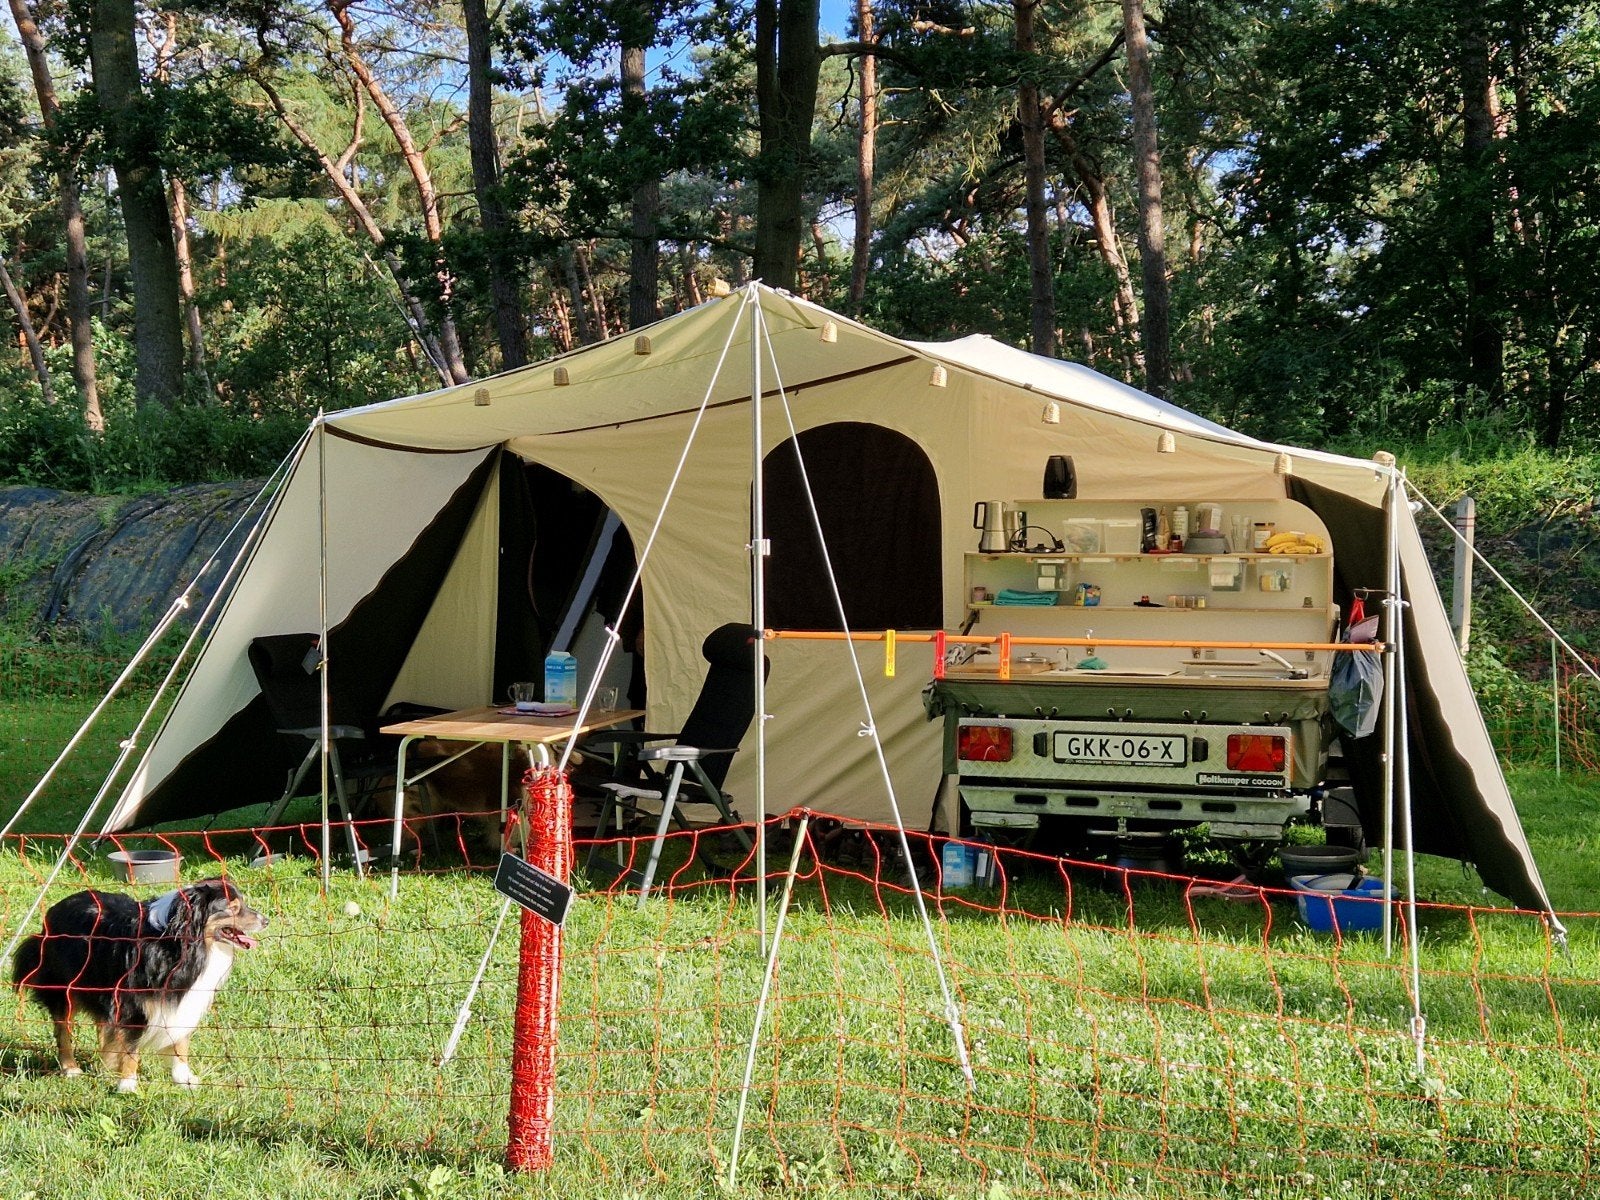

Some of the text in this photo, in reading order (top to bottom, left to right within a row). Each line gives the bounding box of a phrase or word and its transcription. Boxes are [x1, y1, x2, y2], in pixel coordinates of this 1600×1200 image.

[1067, 737, 1173, 760] GKK-06-X
[1199, 774, 1283, 786] Holtkamper COCOON
